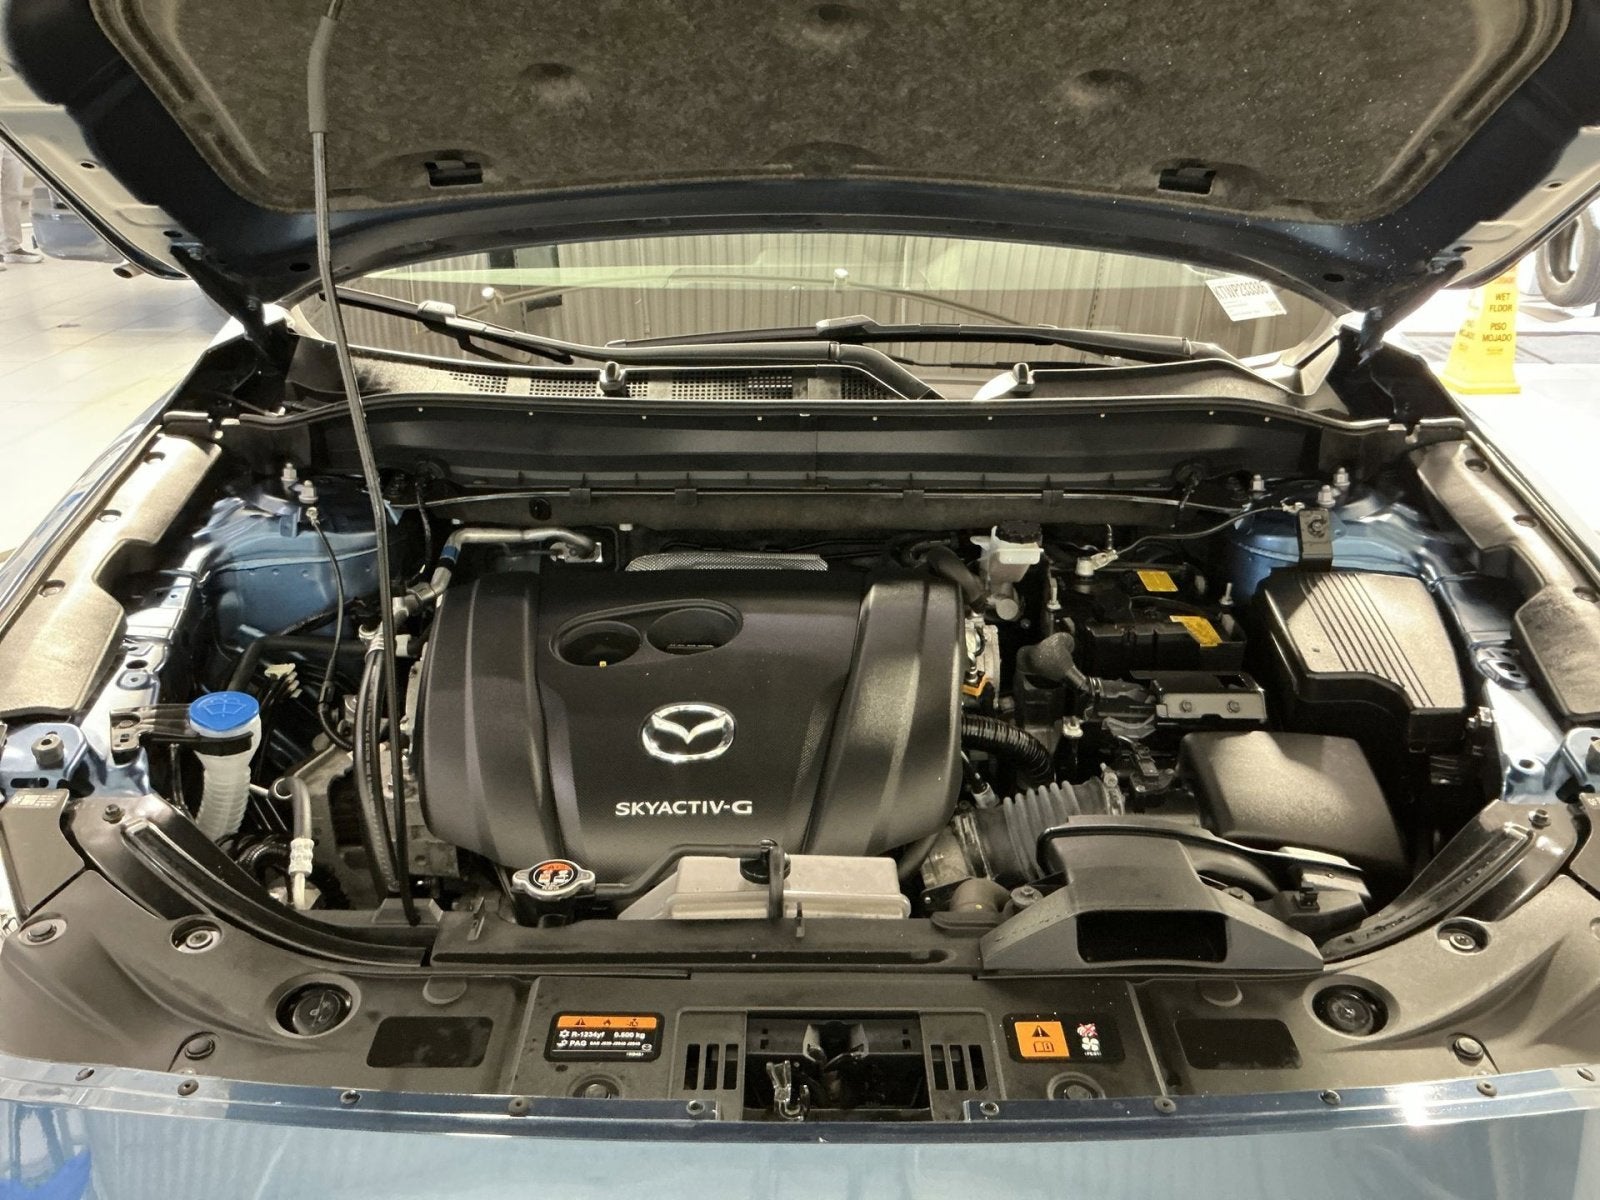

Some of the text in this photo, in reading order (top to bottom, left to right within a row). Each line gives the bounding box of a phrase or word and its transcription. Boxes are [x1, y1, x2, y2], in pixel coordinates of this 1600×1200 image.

[1495, 292, 1511, 301] WET
[1489, 304, 1513, 312] FLOOR
[1490, 322, 1507, 331] PISO
[1482, 333, 1512, 342] MOJADO
[614, 799, 753, 816] SKYACTIV-G
[570, 1031, 605, 1039] R-1234yf
[635, 1031, 646, 1039] kg
[569, 1039, 588, 1047] PAG
